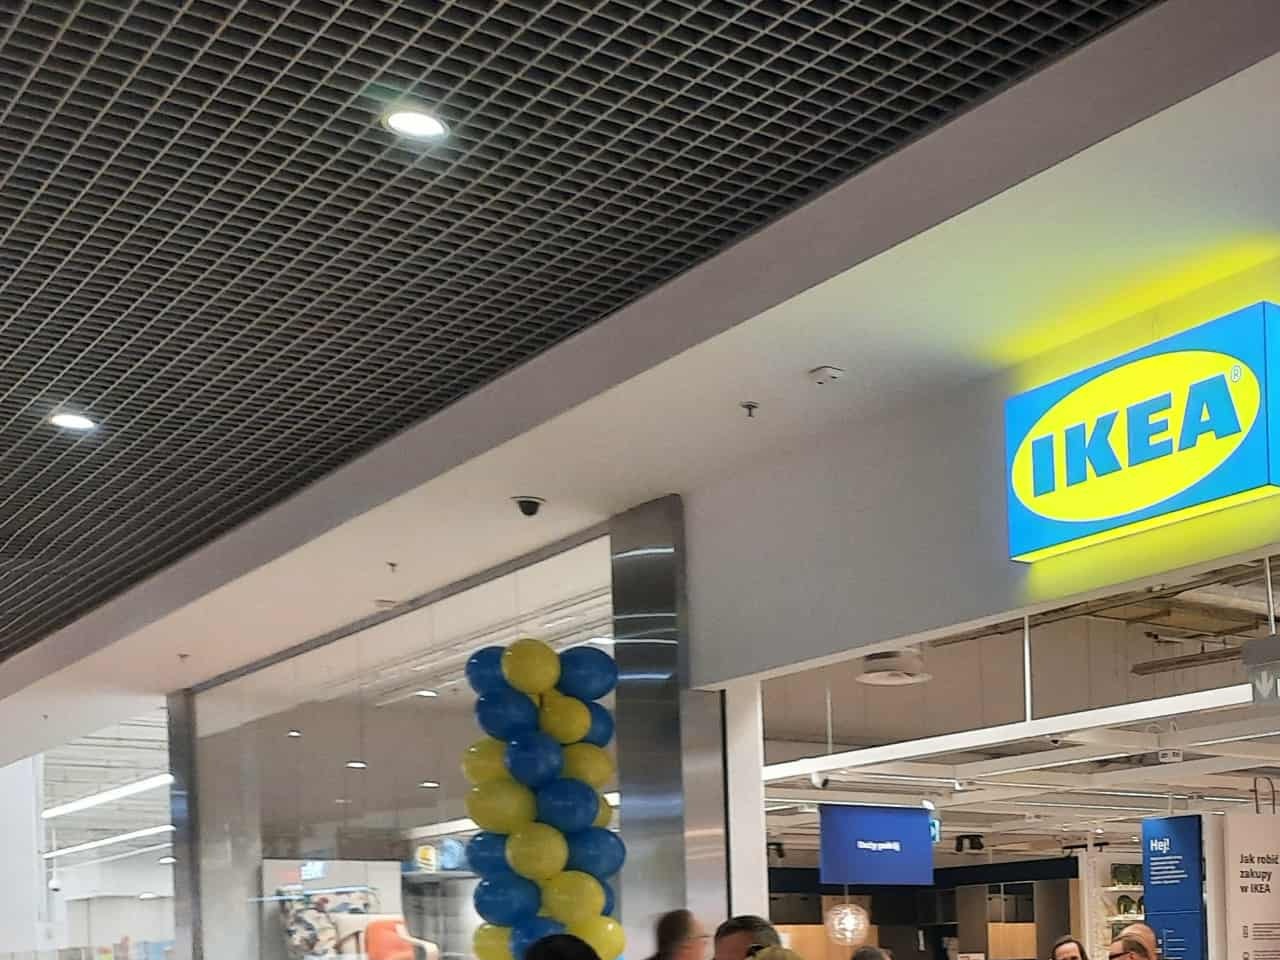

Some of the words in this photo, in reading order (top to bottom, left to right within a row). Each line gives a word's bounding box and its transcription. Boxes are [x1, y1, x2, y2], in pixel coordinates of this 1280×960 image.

[1030, 373, 1242, 498] IKEA
[1149, 838, 1170, 854] Hej!
[1239, 854, 1255, 865] Jak
[1257, 853, 1280, 865] robić
[1239, 869, 1273, 881] zakupy
[1239, 886, 1249, 894] w
[1250, 884, 1271, 894] IKEA
